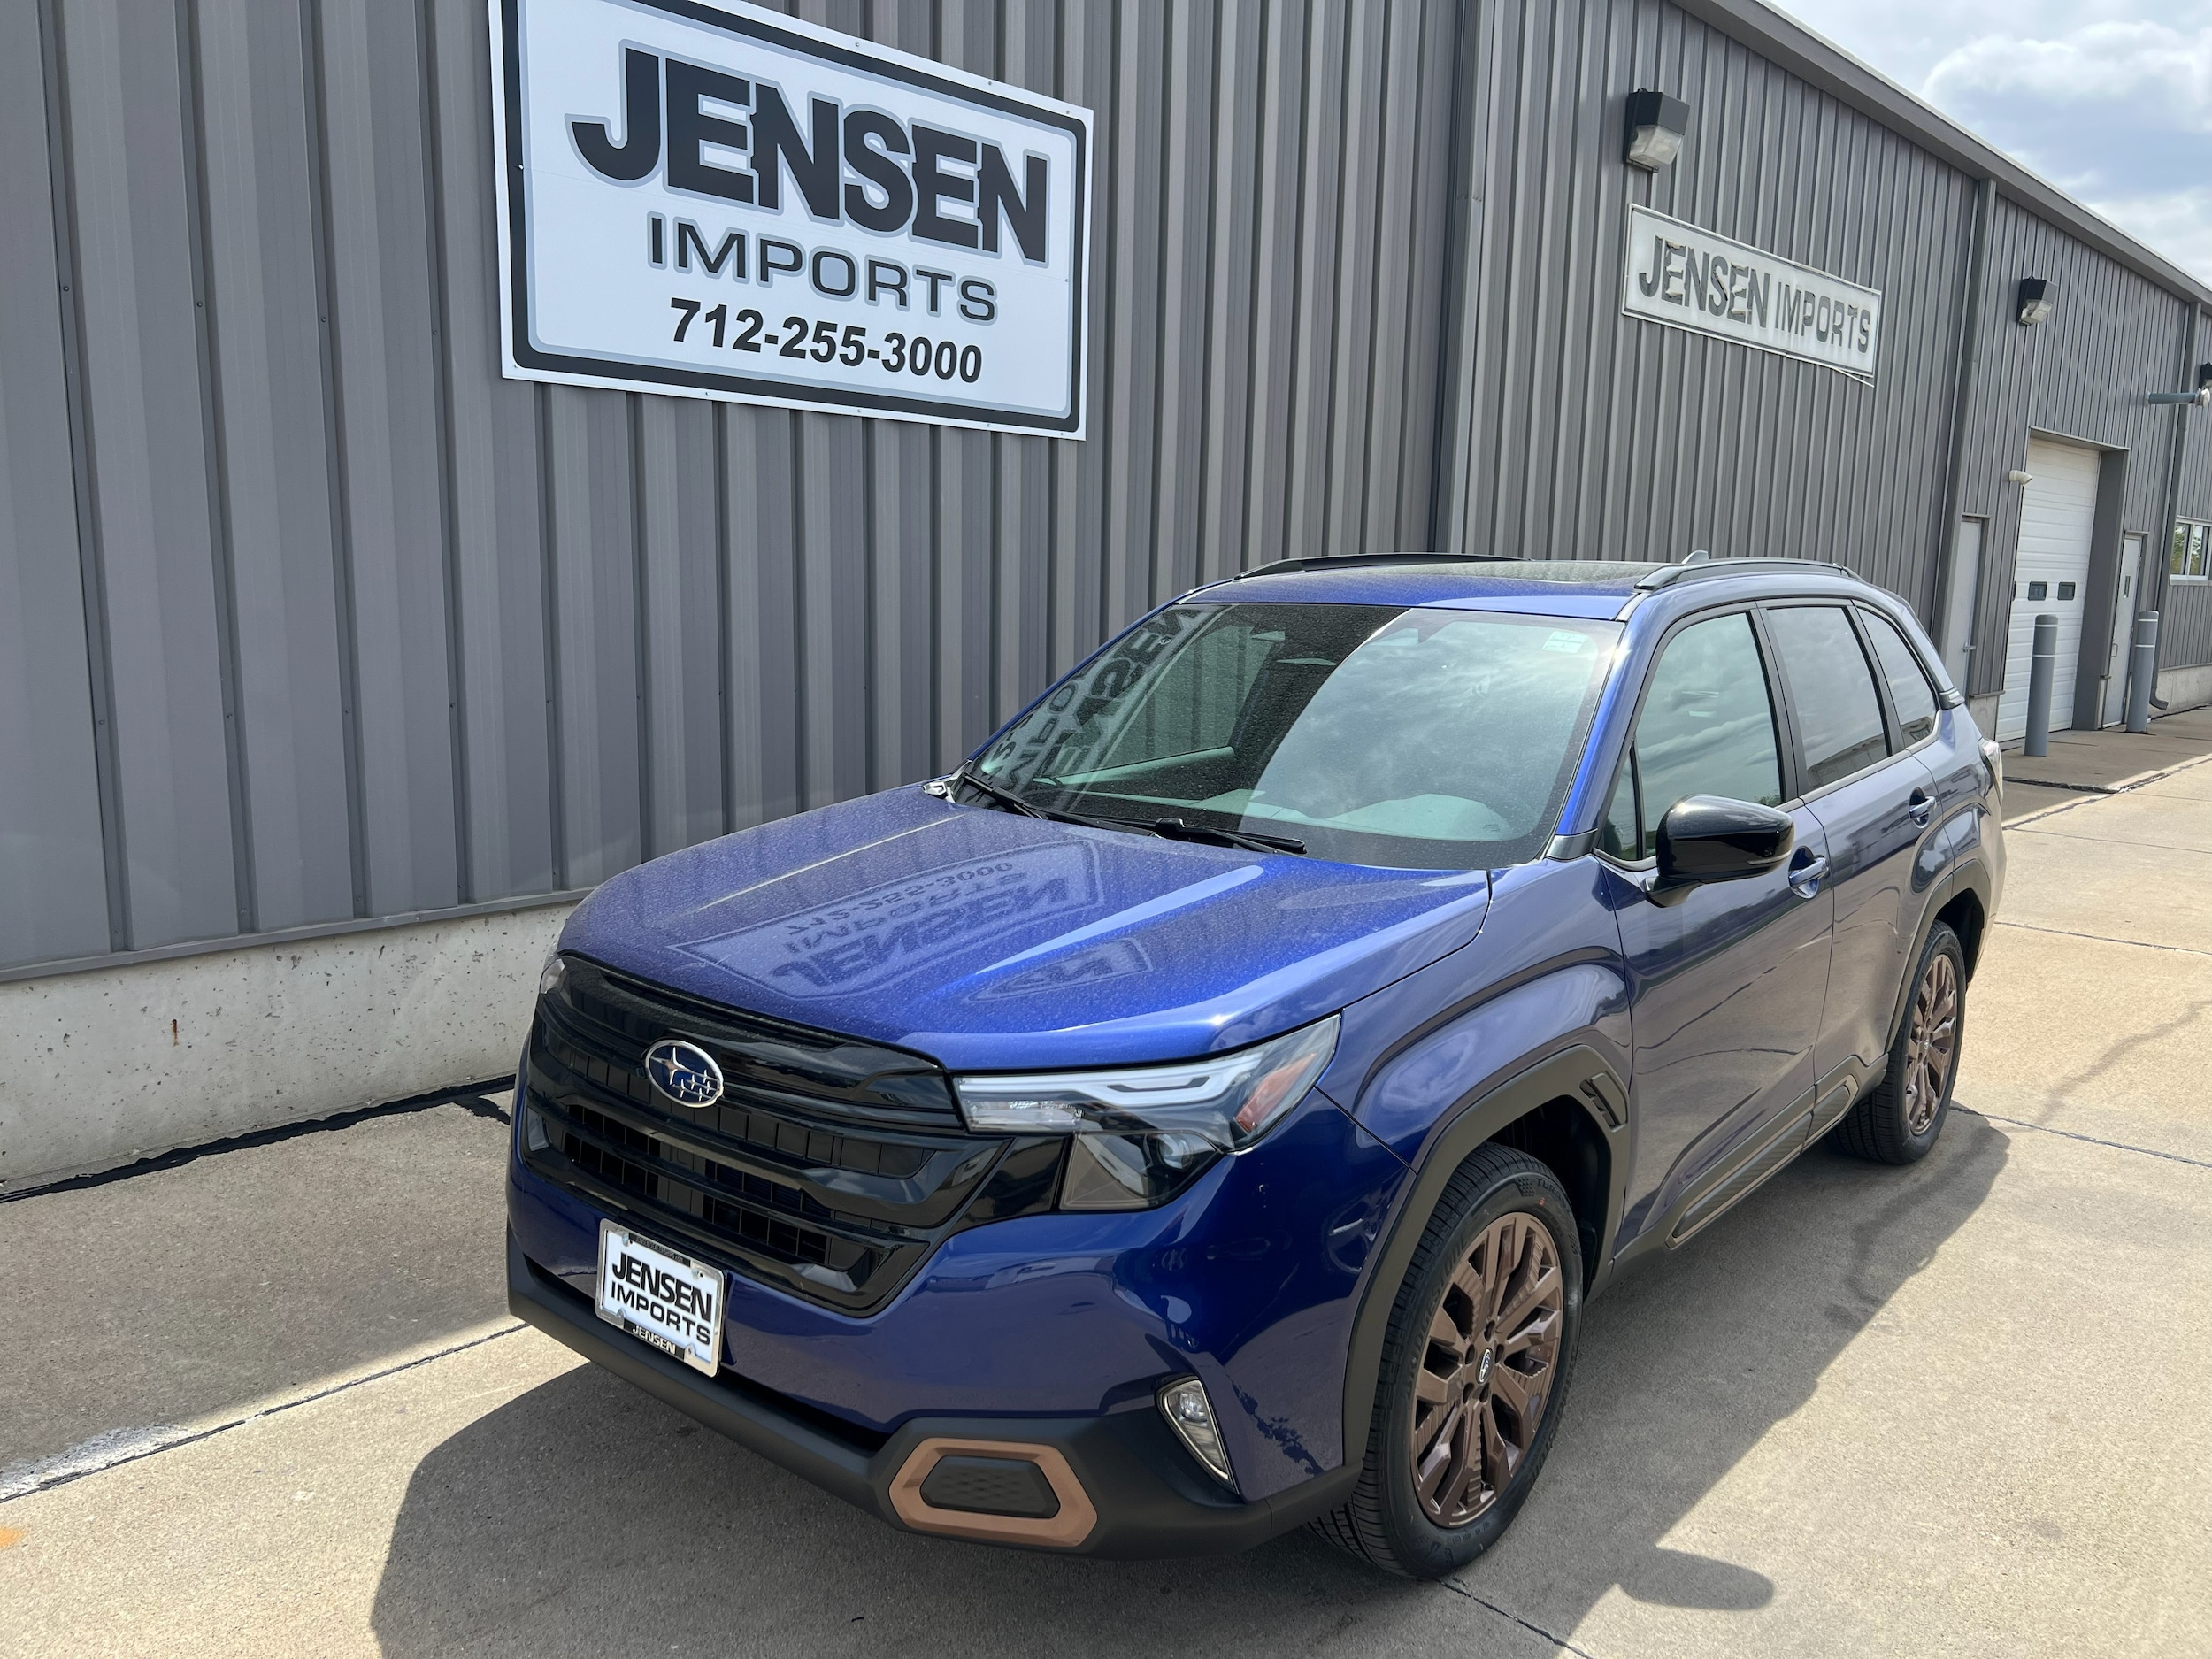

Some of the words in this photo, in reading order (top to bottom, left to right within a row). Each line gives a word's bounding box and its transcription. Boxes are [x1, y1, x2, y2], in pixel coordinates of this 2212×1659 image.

[569, 44, 1048, 264] JENSEN
[649, 216, 997, 323] IMPORTS
[1638, 234, 1770, 328] JENSEN
[1775, 281, 1870, 354] IMPORTS
[669, 296, 983, 383] 712-255-3000
[611, 1251, 713, 1324] JENSEN
[611, 1281, 710, 1346] IMPORTS
[632, 1325, 676, 1355] JENSEN
